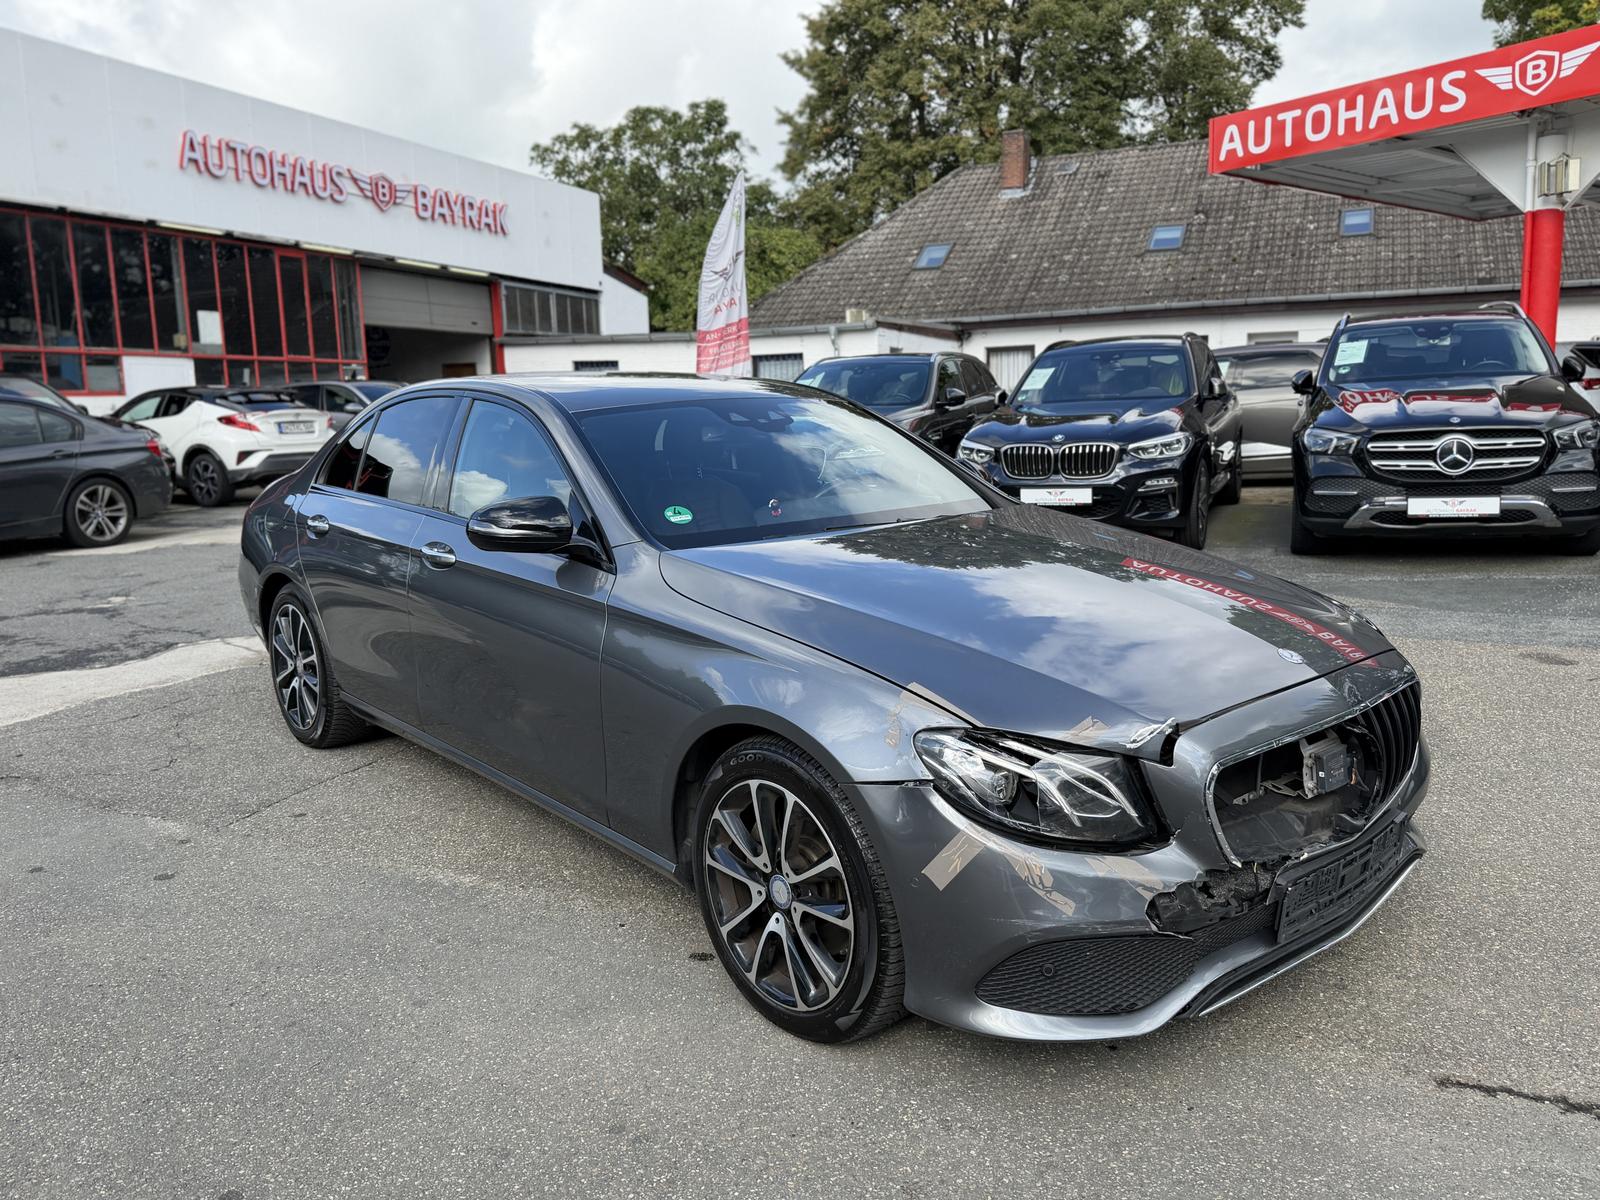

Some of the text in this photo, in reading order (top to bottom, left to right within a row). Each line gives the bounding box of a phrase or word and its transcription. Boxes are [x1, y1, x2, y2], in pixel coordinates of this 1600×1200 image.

[1218, 59, 1547, 161] AUTOHAUS B
[180, 129, 509, 236] AUTOHAUS B BAYRAK
[673, 507, 682, 515] 4
